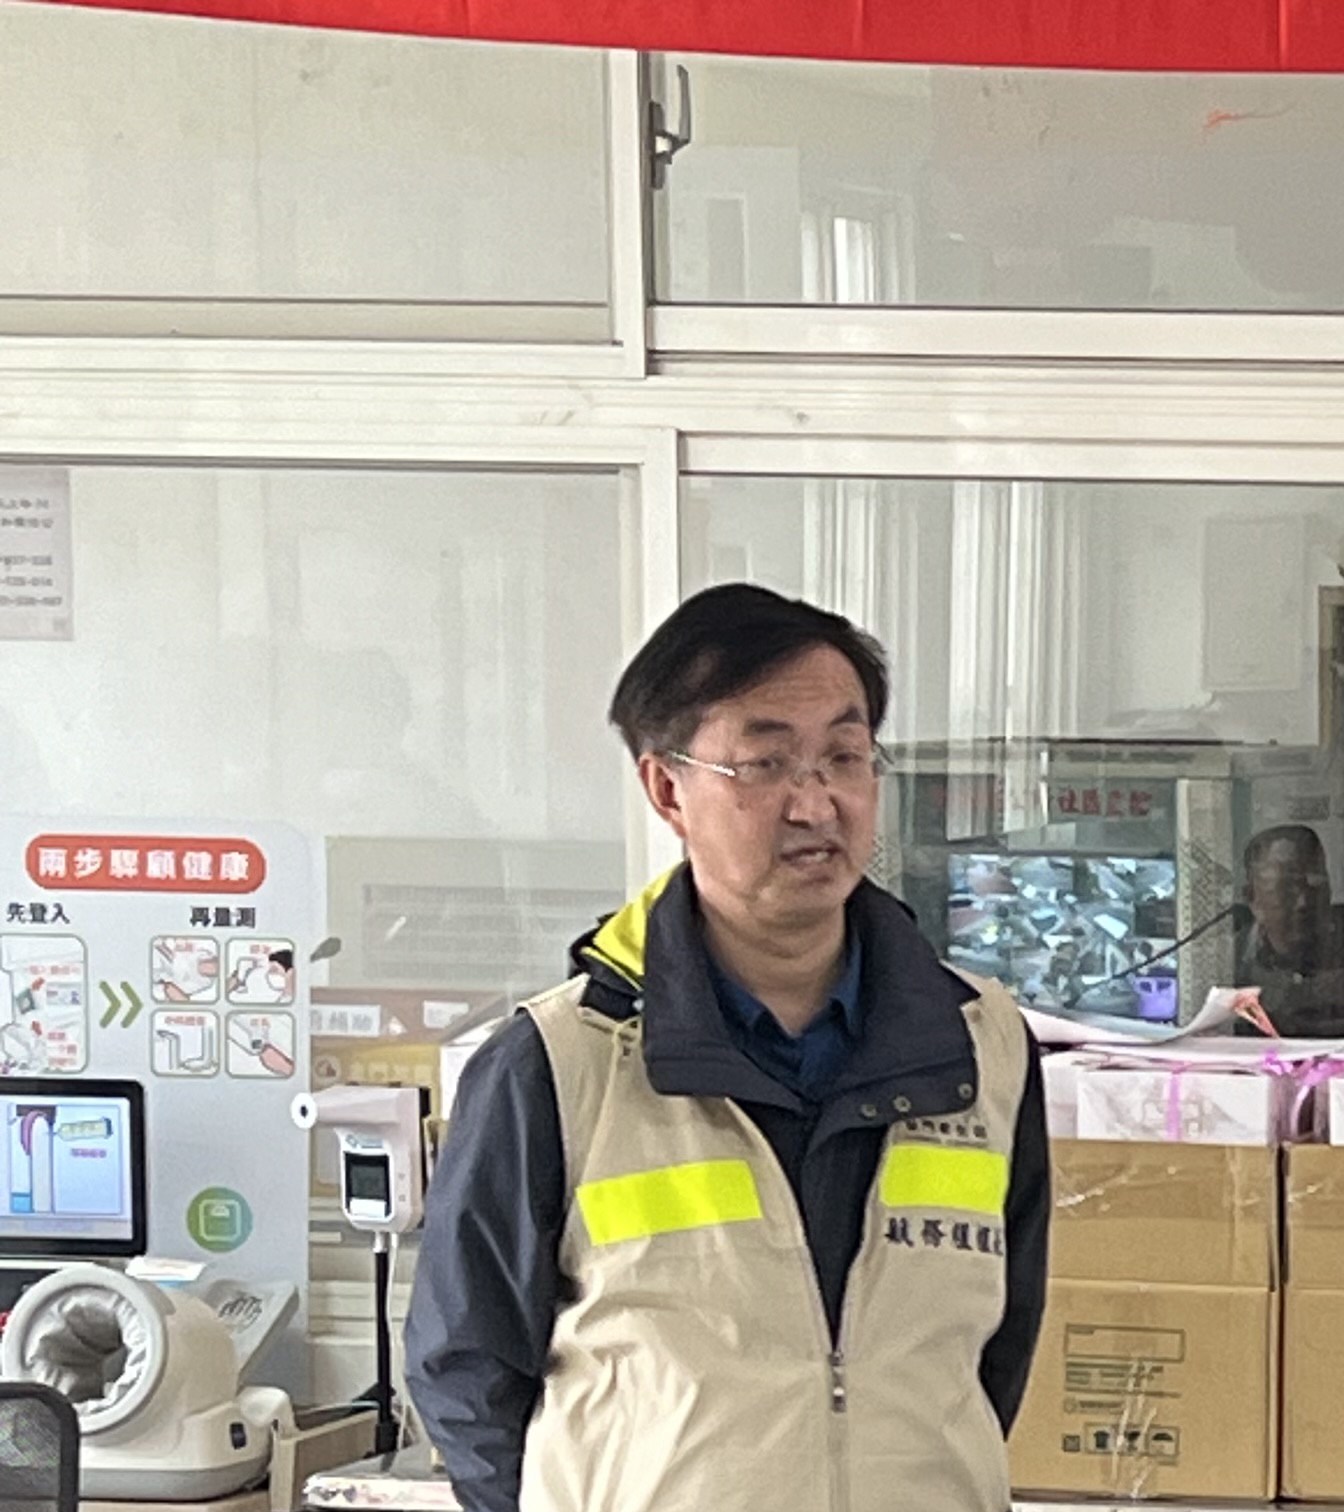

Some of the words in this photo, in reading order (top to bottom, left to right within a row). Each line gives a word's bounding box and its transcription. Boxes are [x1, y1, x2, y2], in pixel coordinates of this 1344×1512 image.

[38, 847, 251, 881] 兩步驟顧健康
[6, 902, 71, 925] 先登入
[189, 905, 257, 928] 再量測
